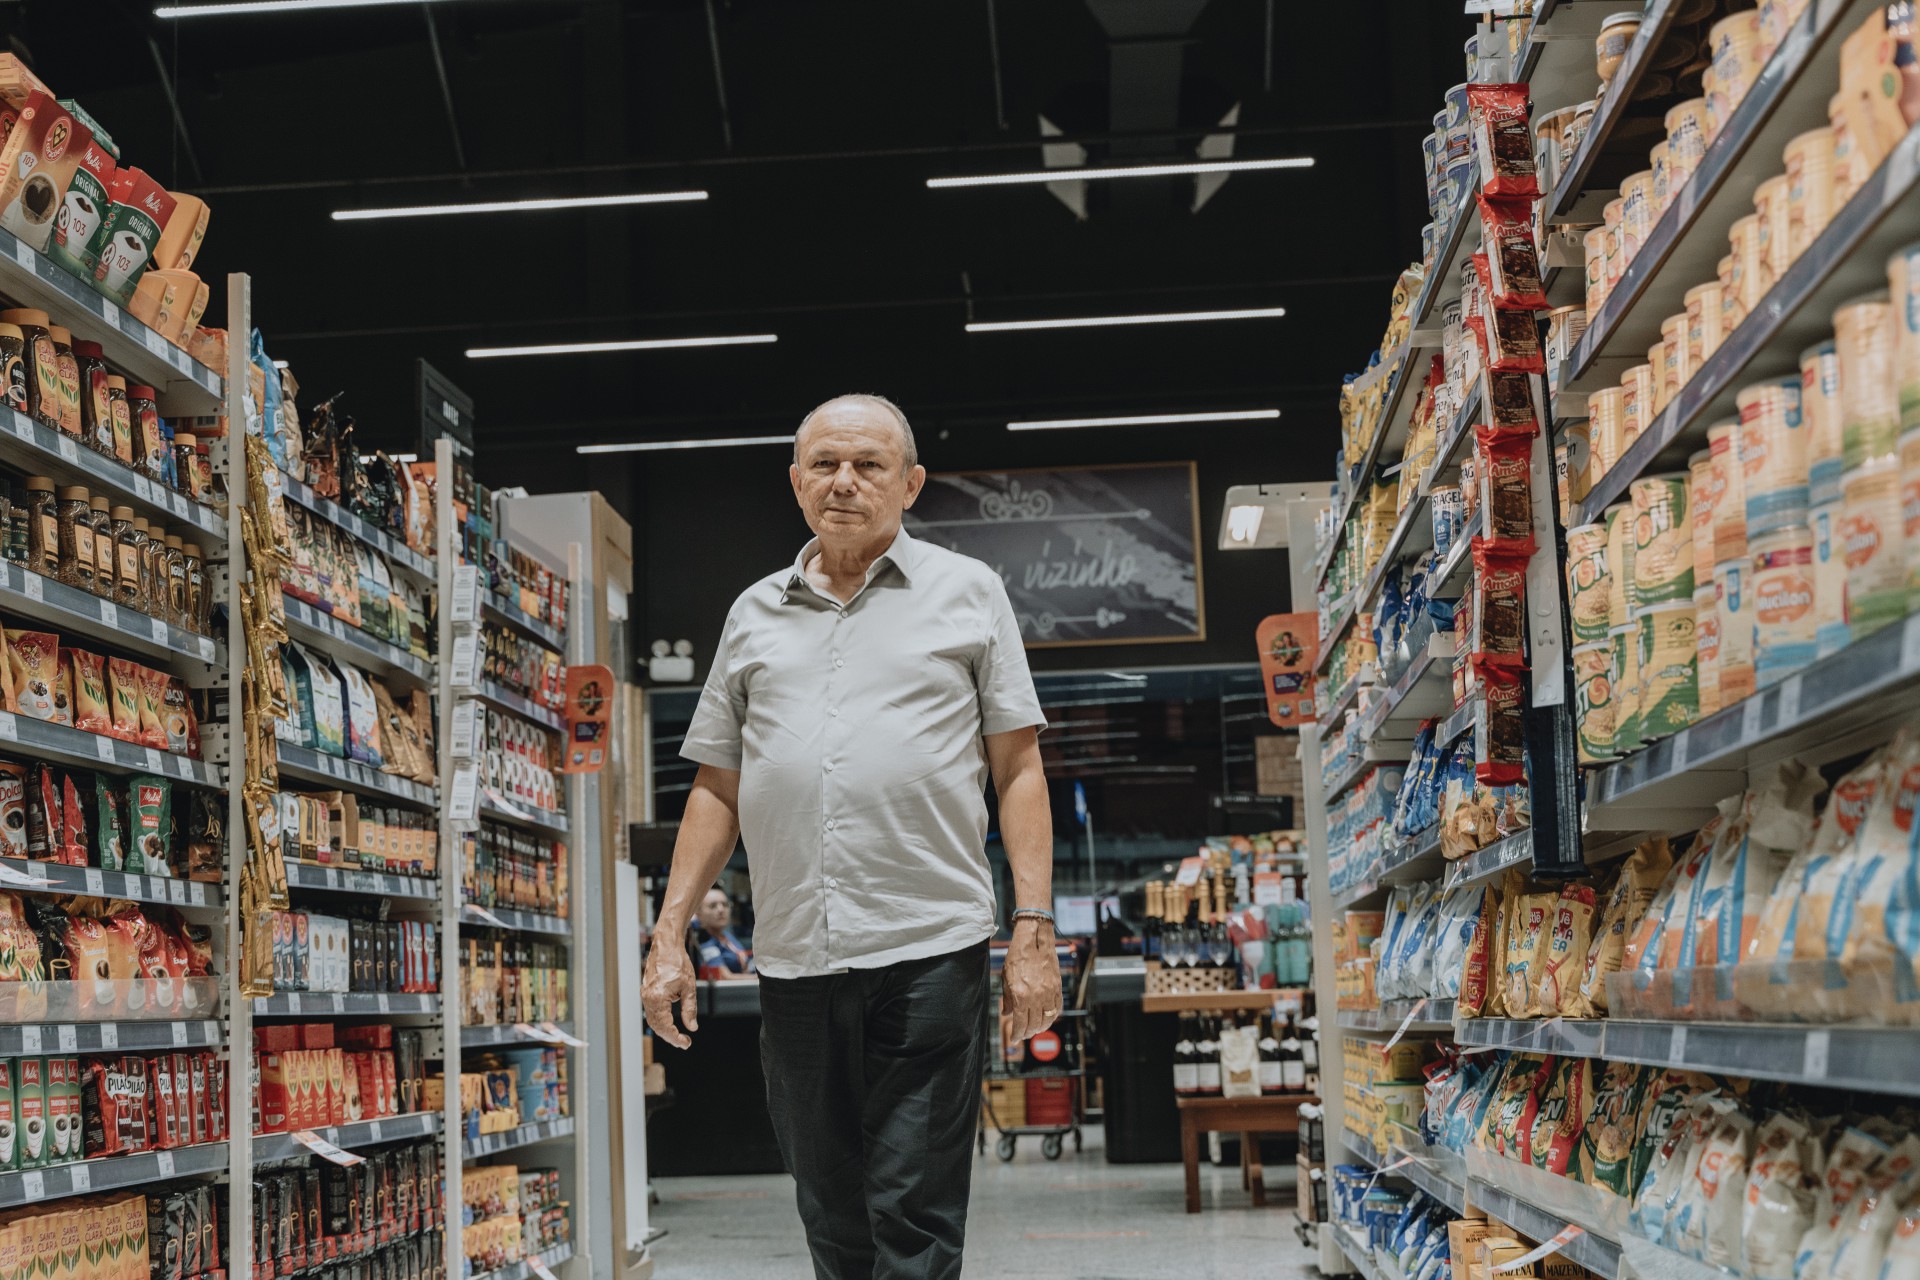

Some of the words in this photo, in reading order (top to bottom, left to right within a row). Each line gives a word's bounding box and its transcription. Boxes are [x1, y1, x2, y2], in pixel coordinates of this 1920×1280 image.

[75, 174, 100, 201] ORIGINAL
[72, 218, 87, 237] 103
[128, 215, 153, 240] ORIGINAL
[116, 255, 131, 271] 103
[128, 1076, 145, 1094] ILÃO
[127, 1210, 142, 1220] SANTA
[63, 1225, 79, 1236] SANTA
[126, 1219, 145, 1231] CLARA
[40, 1232, 56, 1242] SANTA
[61, 1235, 80, 1247] CLARA
[37, 1242, 57, 1254] CLARA
